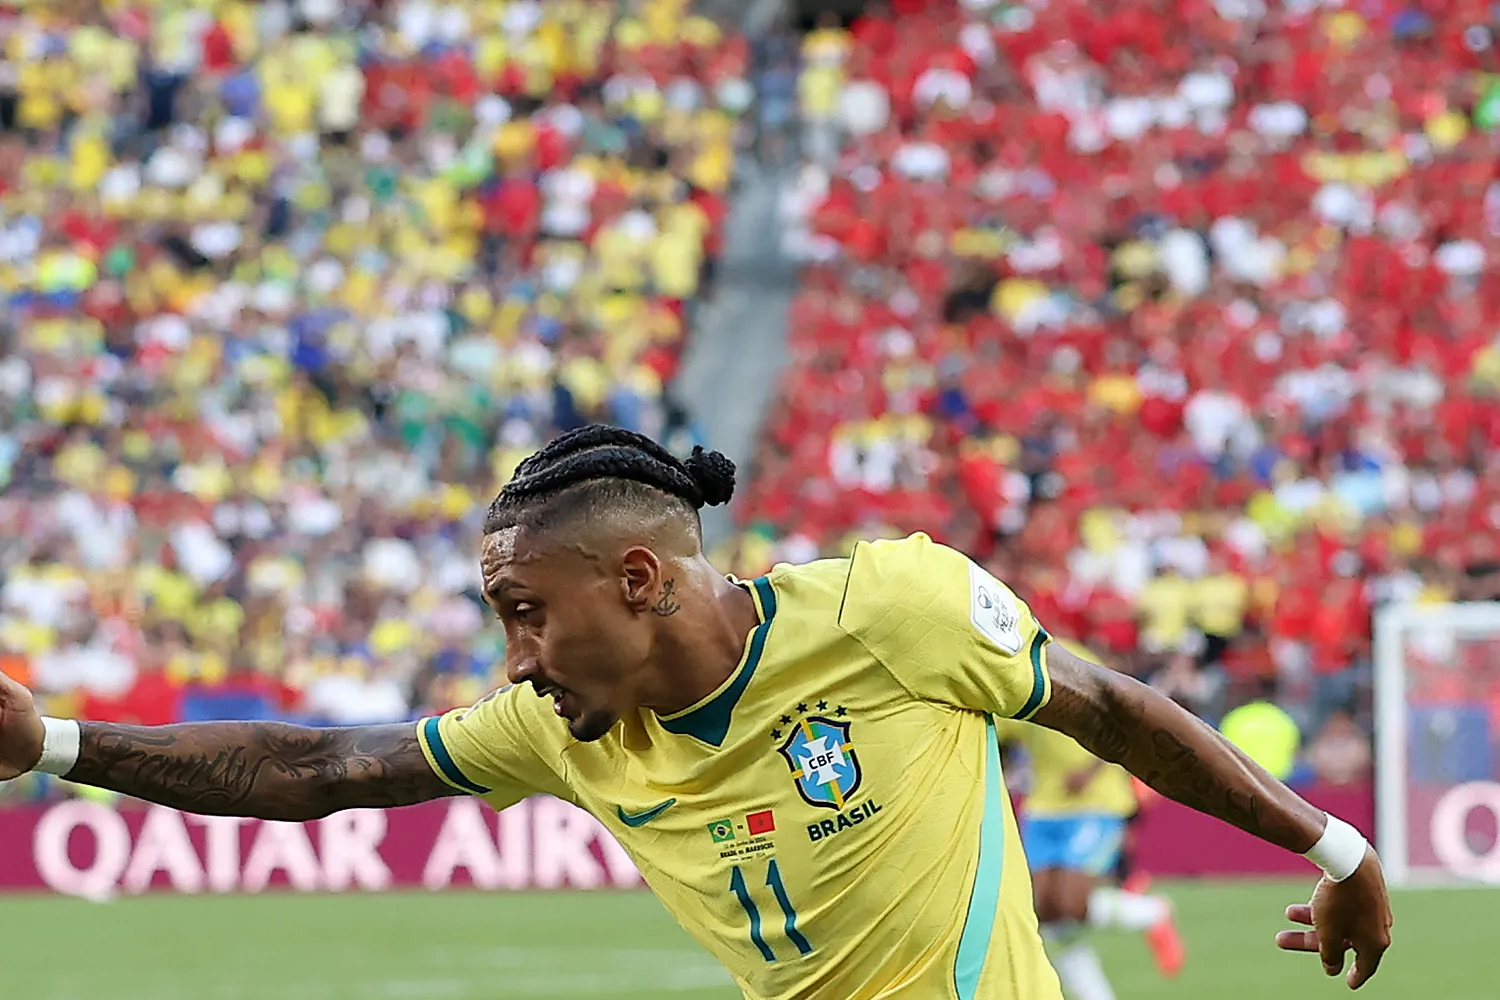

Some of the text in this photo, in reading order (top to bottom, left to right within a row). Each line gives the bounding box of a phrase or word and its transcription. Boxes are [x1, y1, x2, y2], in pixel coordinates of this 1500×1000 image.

[808, 751, 835, 770] CBF
[32, 800, 393, 904] QATAR
[807, 799, 883, 842] BRASIL
[729, 858, 813, 962] 11
